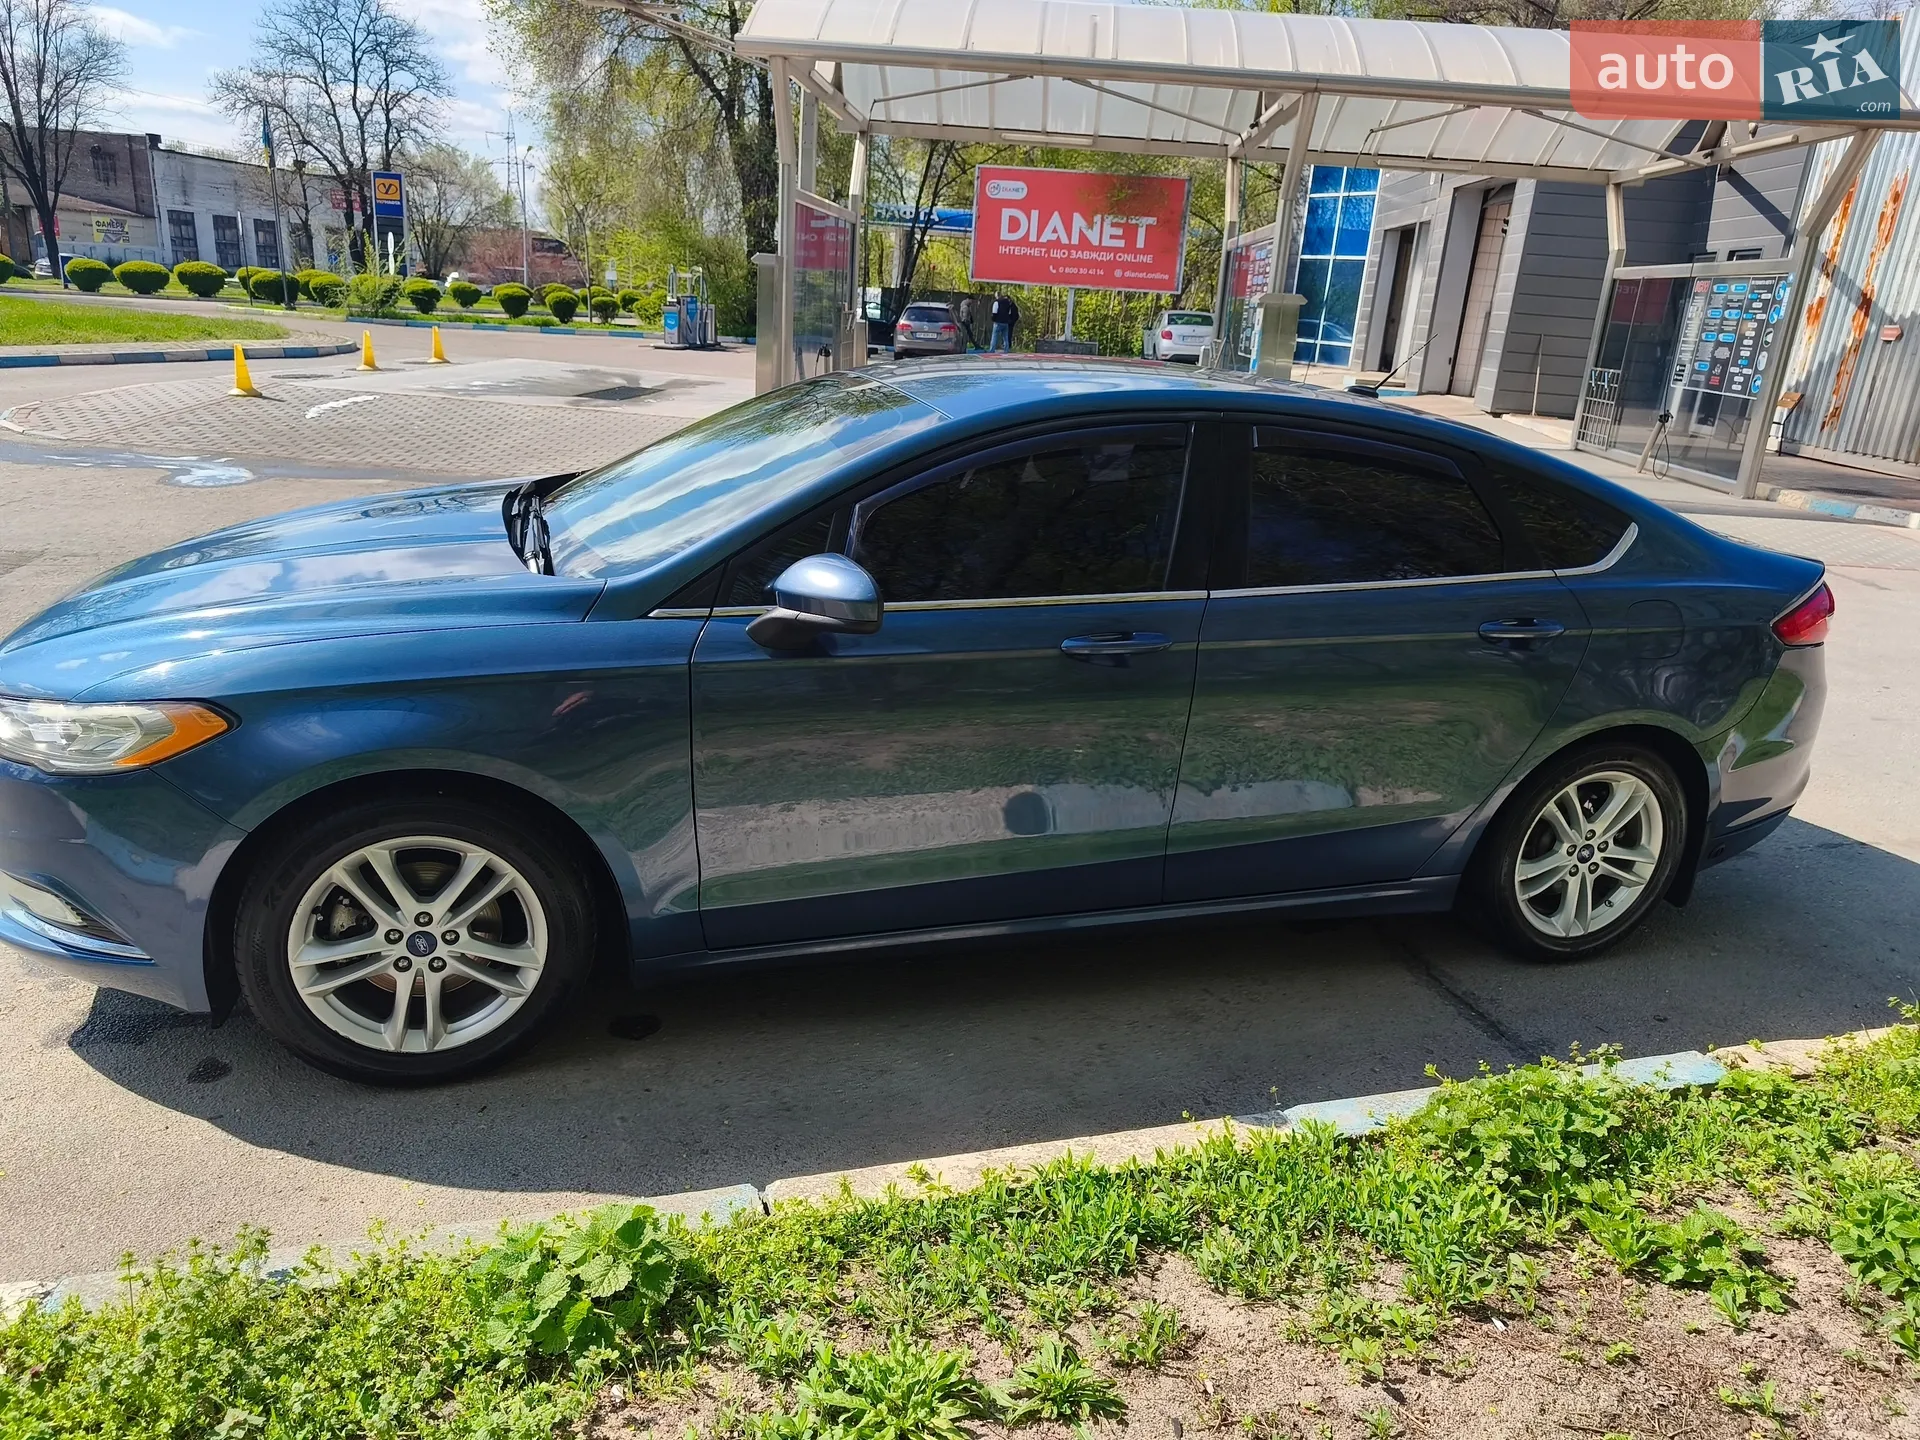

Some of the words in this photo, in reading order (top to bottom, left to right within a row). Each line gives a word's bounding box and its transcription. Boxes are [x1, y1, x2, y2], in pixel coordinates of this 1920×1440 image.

[1000, 208, 1157, 248] DIANET
[998, 245, 1048, 259] ІНТЕРНЕТ,
[1050, 249, 1068, 259] ЩО
[1069, 250, 1114, 262] ЗАВЖДИ
[1116, 252, 1153, 263] ONLINE
[1124, 269, 1169, 281] dianet.online
